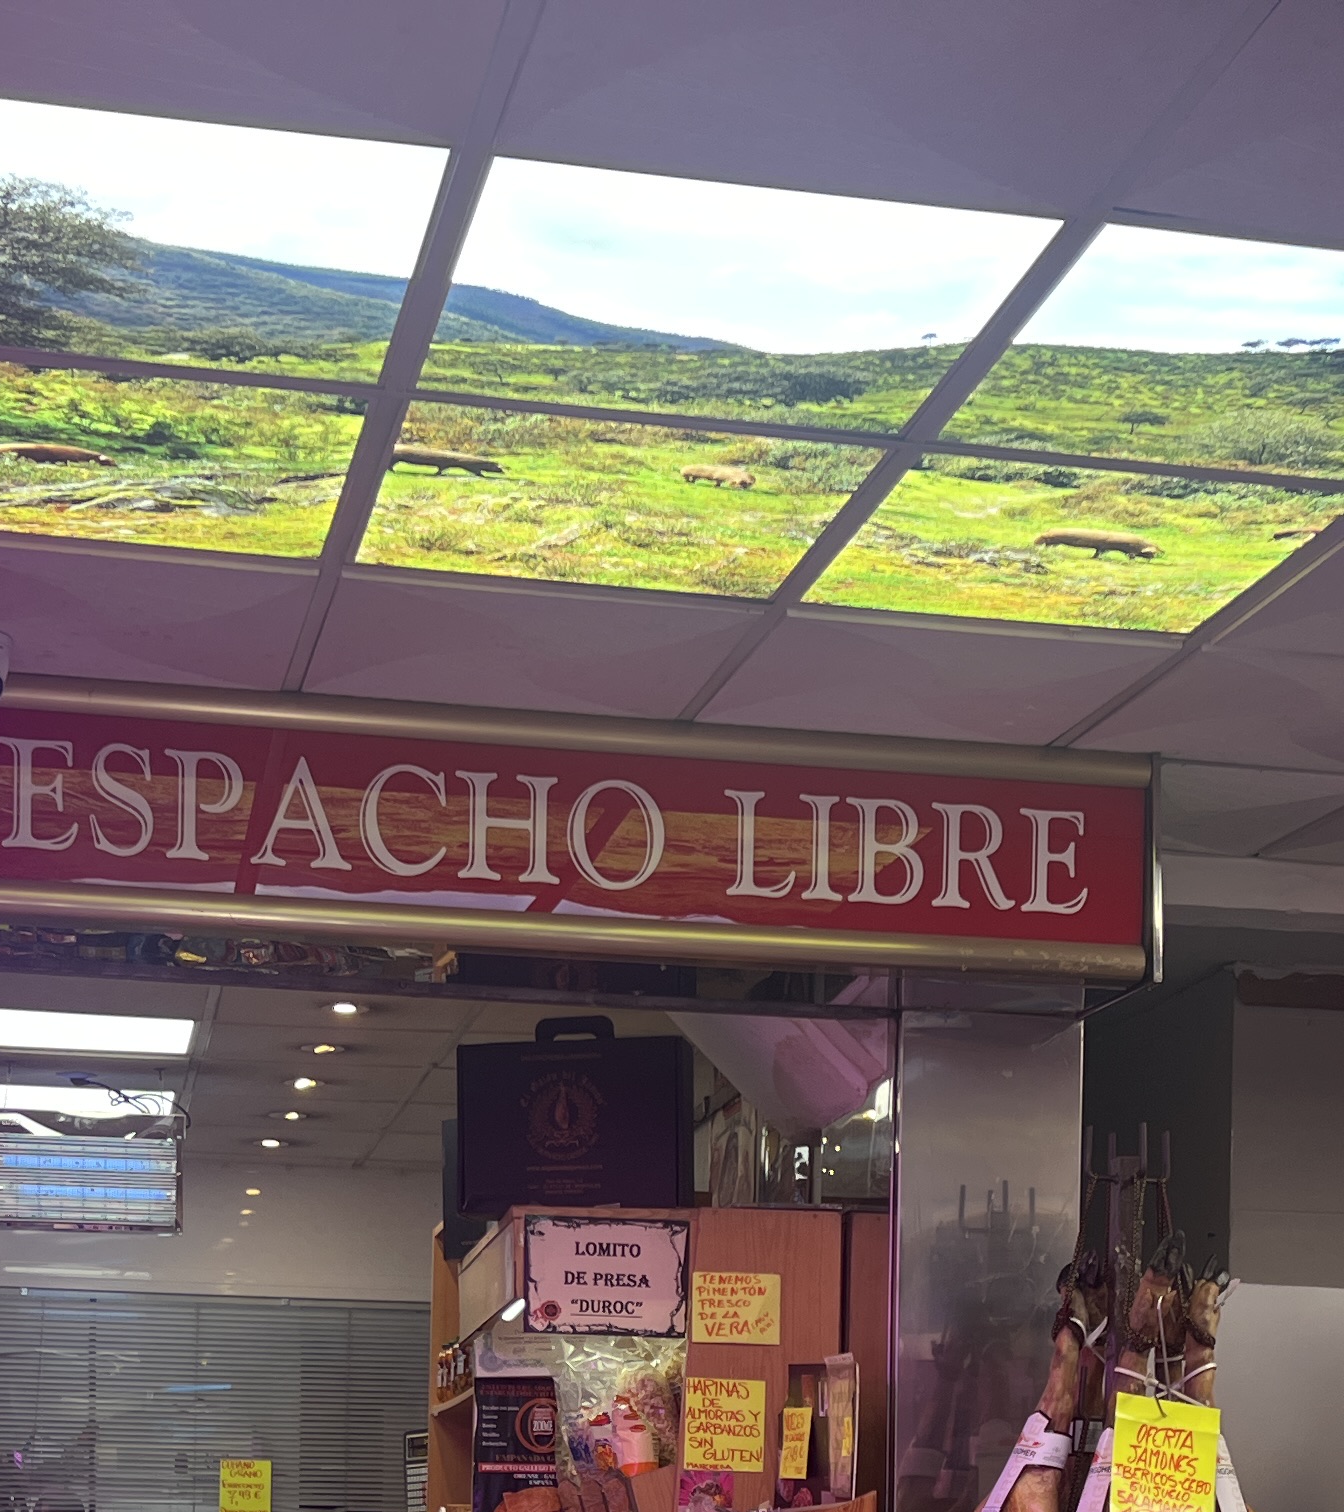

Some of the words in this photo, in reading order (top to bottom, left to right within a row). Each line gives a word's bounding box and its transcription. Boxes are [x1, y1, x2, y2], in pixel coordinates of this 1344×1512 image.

[726, 790, 1089, 915] LIBRE
[575, 1241, 641, 1259] LOMITO
[564, 1271, 588, 1286] DE
[592, 1271, 651, 1289] PRESA
[699, 1274, 762, 1285] TENEMOS
[698, 1299, 751, 1310] FRESCO
[698, 1312, 717, 1320] DE
[722, 1311, 740, 1319] LA
[704, 1320, 751, 1338] VERA
[687, 1379, 750, 1400] HARINAS
[702, 1398, 723, 1409] DE
[686, 1409, 745, 1422] ALMORTAS
[748, 1410, 761, 1422] Y
[687, 1422, 761, 1437] GARBANZOS
[689, 1437, 714, 1449] SIN
[1137, 1424, 1193, 1454] OFERTA
[703, 1447, 763, 1462] GLUTEN!
[1127, 1444, 1199, 1477] JAMONES
[1130, 1482, 1190, 1502] GUIJUELO
